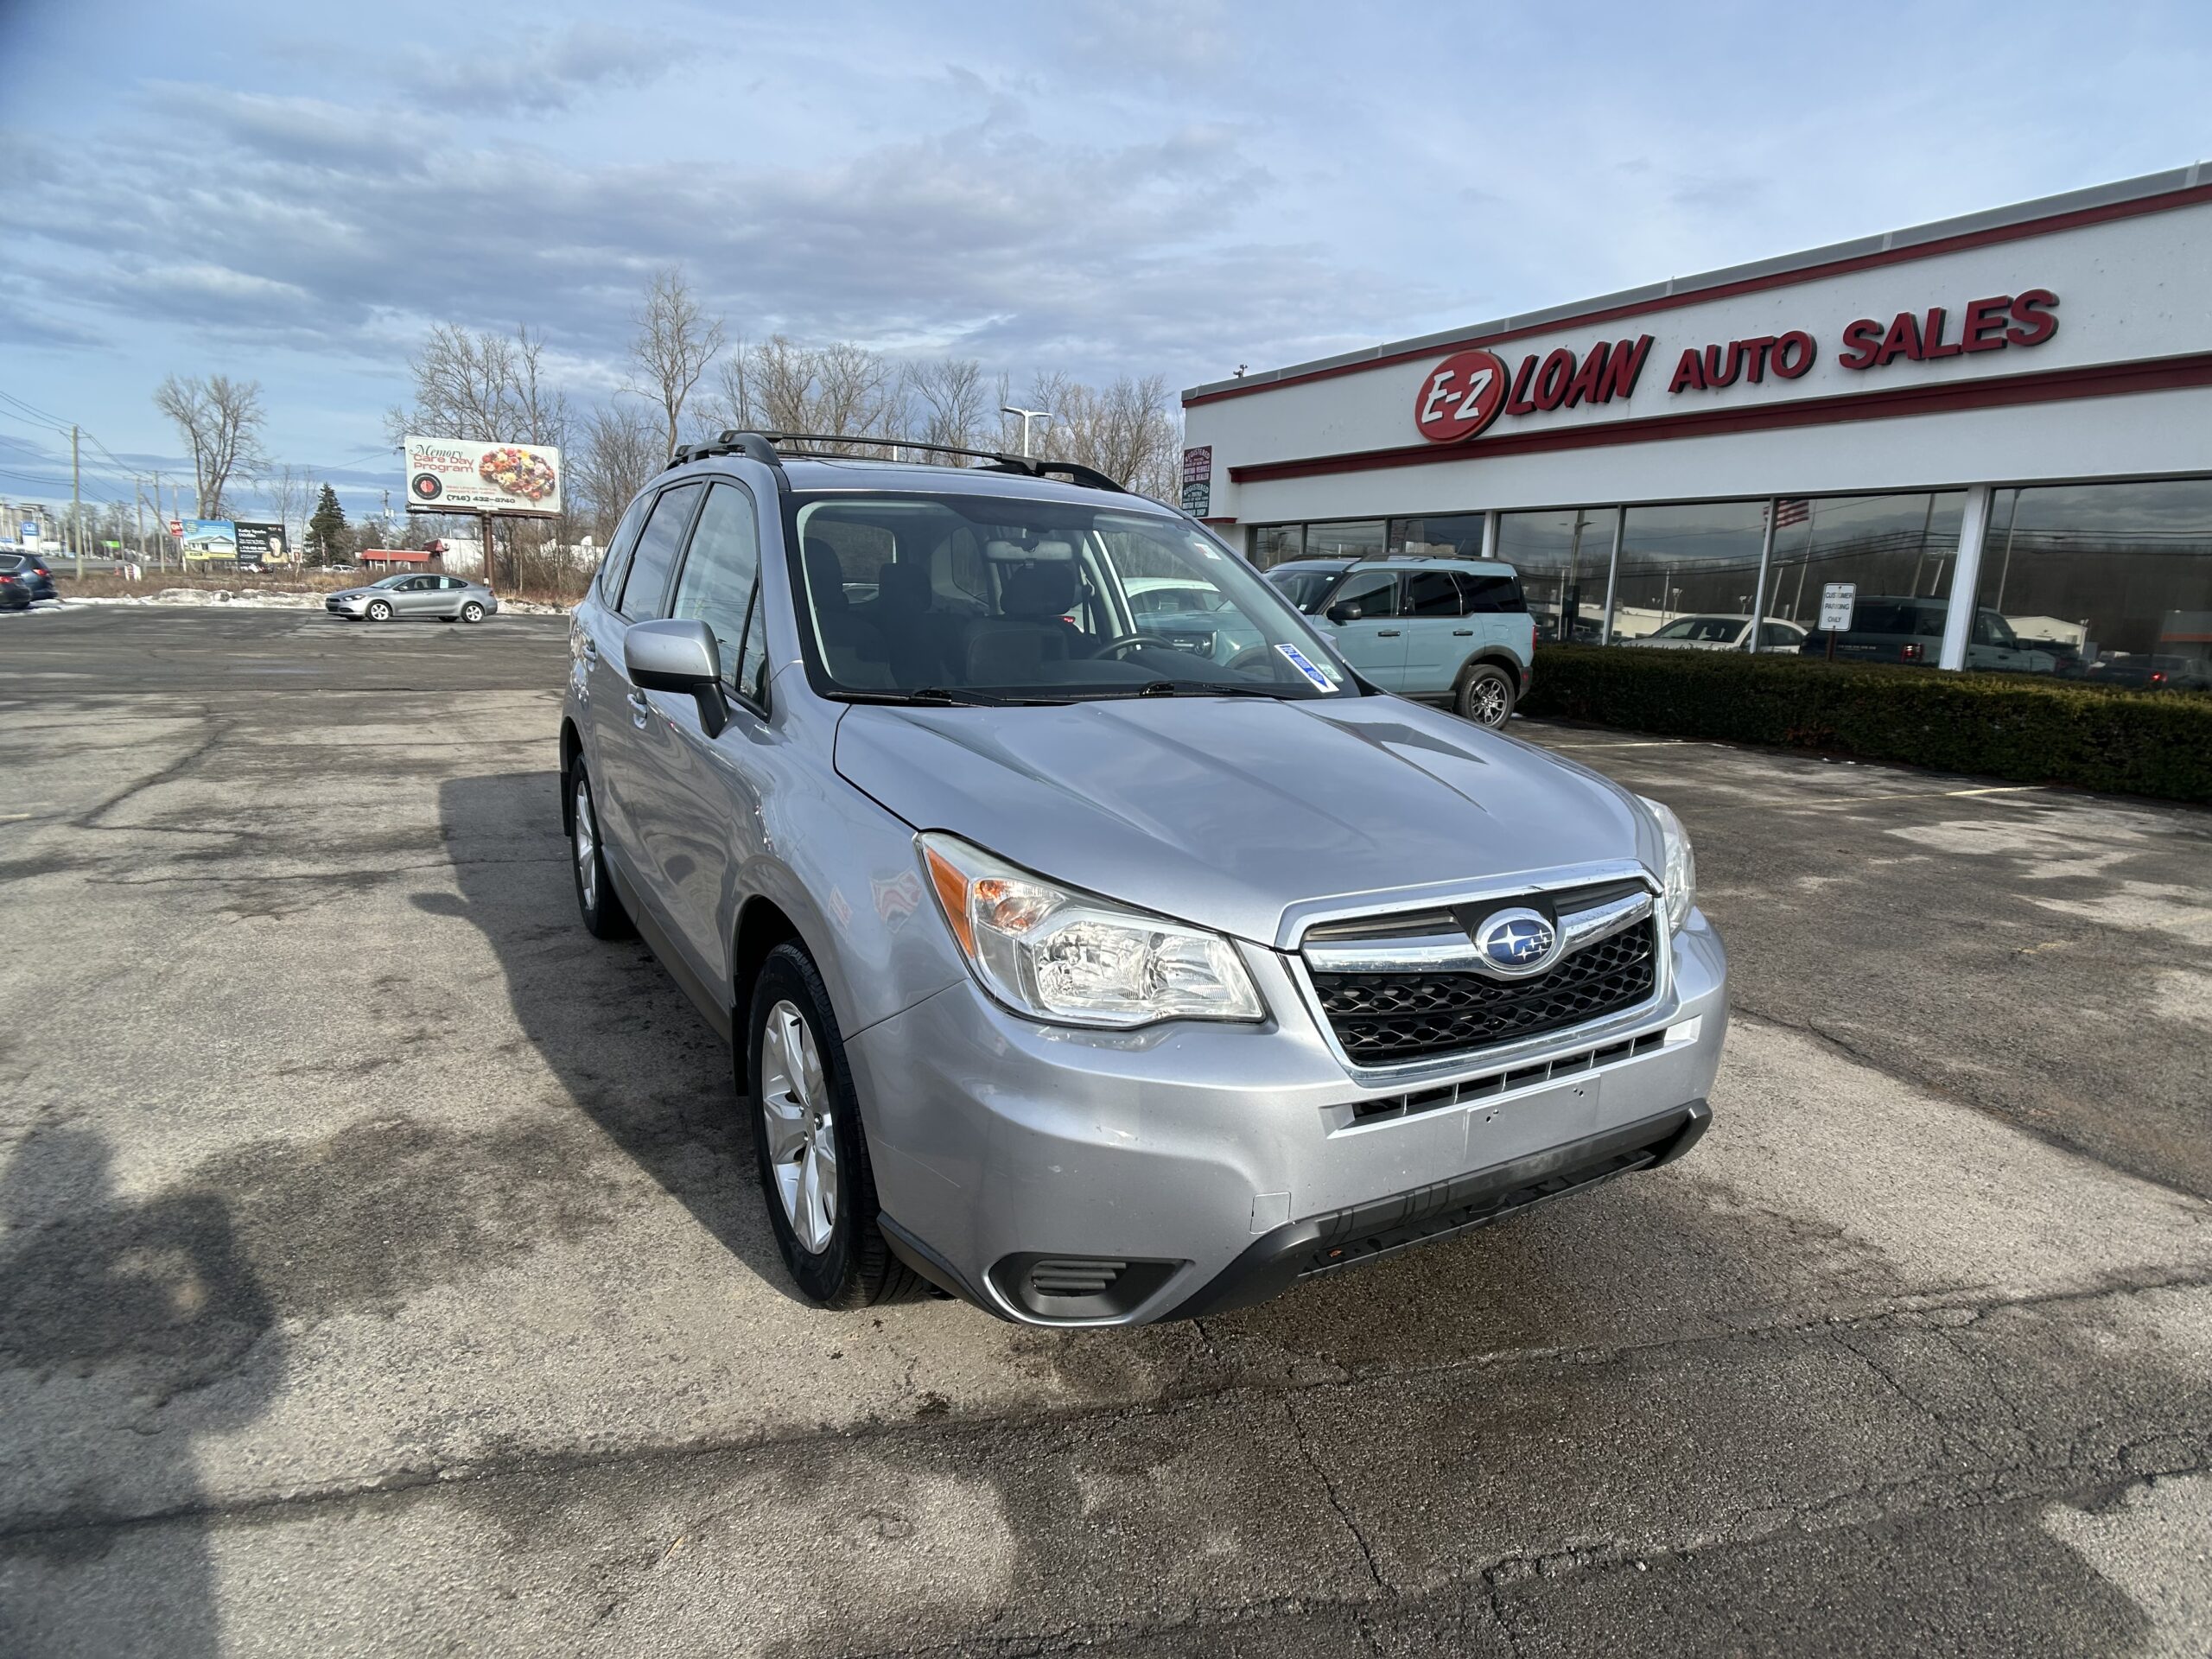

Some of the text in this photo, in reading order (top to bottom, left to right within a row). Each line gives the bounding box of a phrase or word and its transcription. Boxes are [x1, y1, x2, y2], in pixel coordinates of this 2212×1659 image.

[1421, 289, 2061, 423] E-Z LOAN AUTO SALES
[409, 444, 463, 459] Memory
[1185, 448, 1211, 462] REGISTERED
[414, 454, 474, 467] Care Day
[414, 462, 474, 473] Program
[1196, 473, 1209, 481] DEALER
[1184, 484, 1210, 495] REGISTERED
